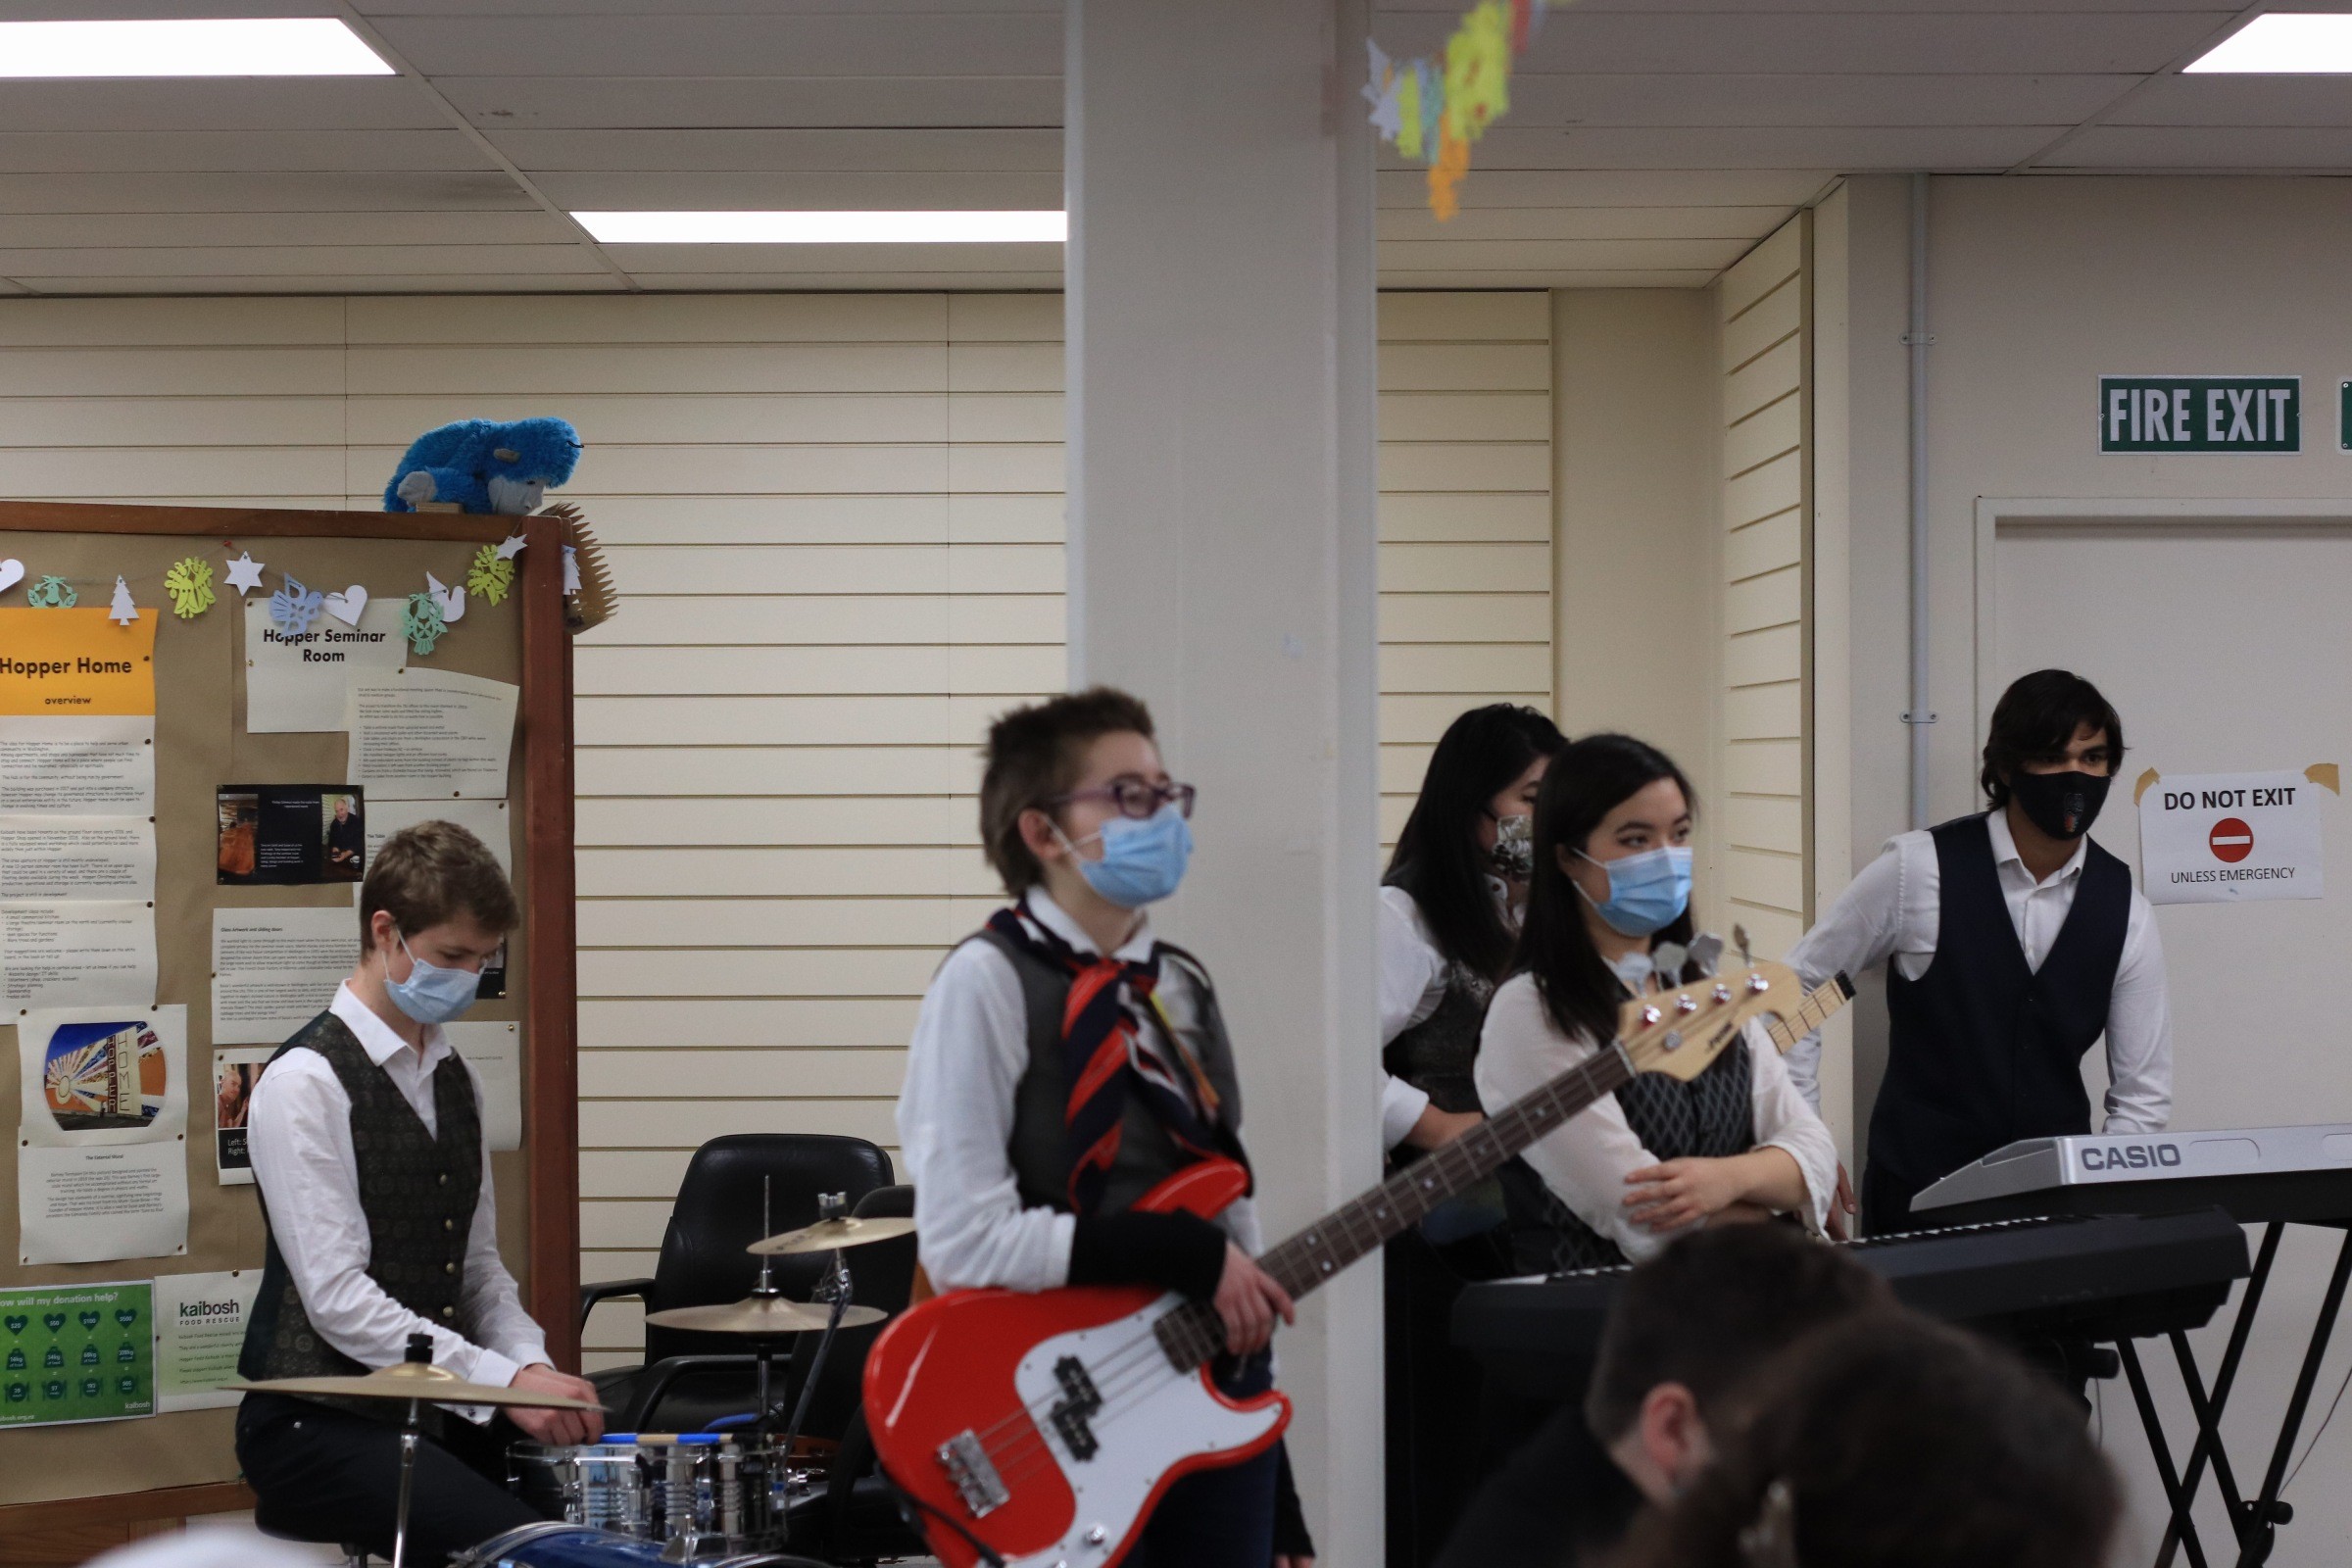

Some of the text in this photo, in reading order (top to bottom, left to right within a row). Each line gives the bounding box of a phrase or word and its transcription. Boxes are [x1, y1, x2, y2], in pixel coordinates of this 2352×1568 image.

[2109, 388, 2291, 442] FIRE EXIT
[264, 628, 386, 647] Hopper Seminar
[303, 648, 345, 663] Room
[0, 657, 132, 678] Hopper Home
[44, 695, 92, 706] overview
[2164, 787, 2296, 811] DO NOT EXIT
[2171, 866, 2296, 884] UNLESS EMERGENCY
[108, 1036, 117, 1113] HOPPER
[117, 1032, 130, 1111] HOME
[228, 1138, 241, 1146] Left:
[228, 1147, 245, 1156] Right:
[2081, 1143, 2181, 1171] CASIO
[17, 1297, 34, 1306] will
[37, 1298, 50, 1306] my
[53, 1294, 92, 1305] donation
[94, 1292, 118, 1302] help?
[180, 1299, 240, 1318] kaibosh
